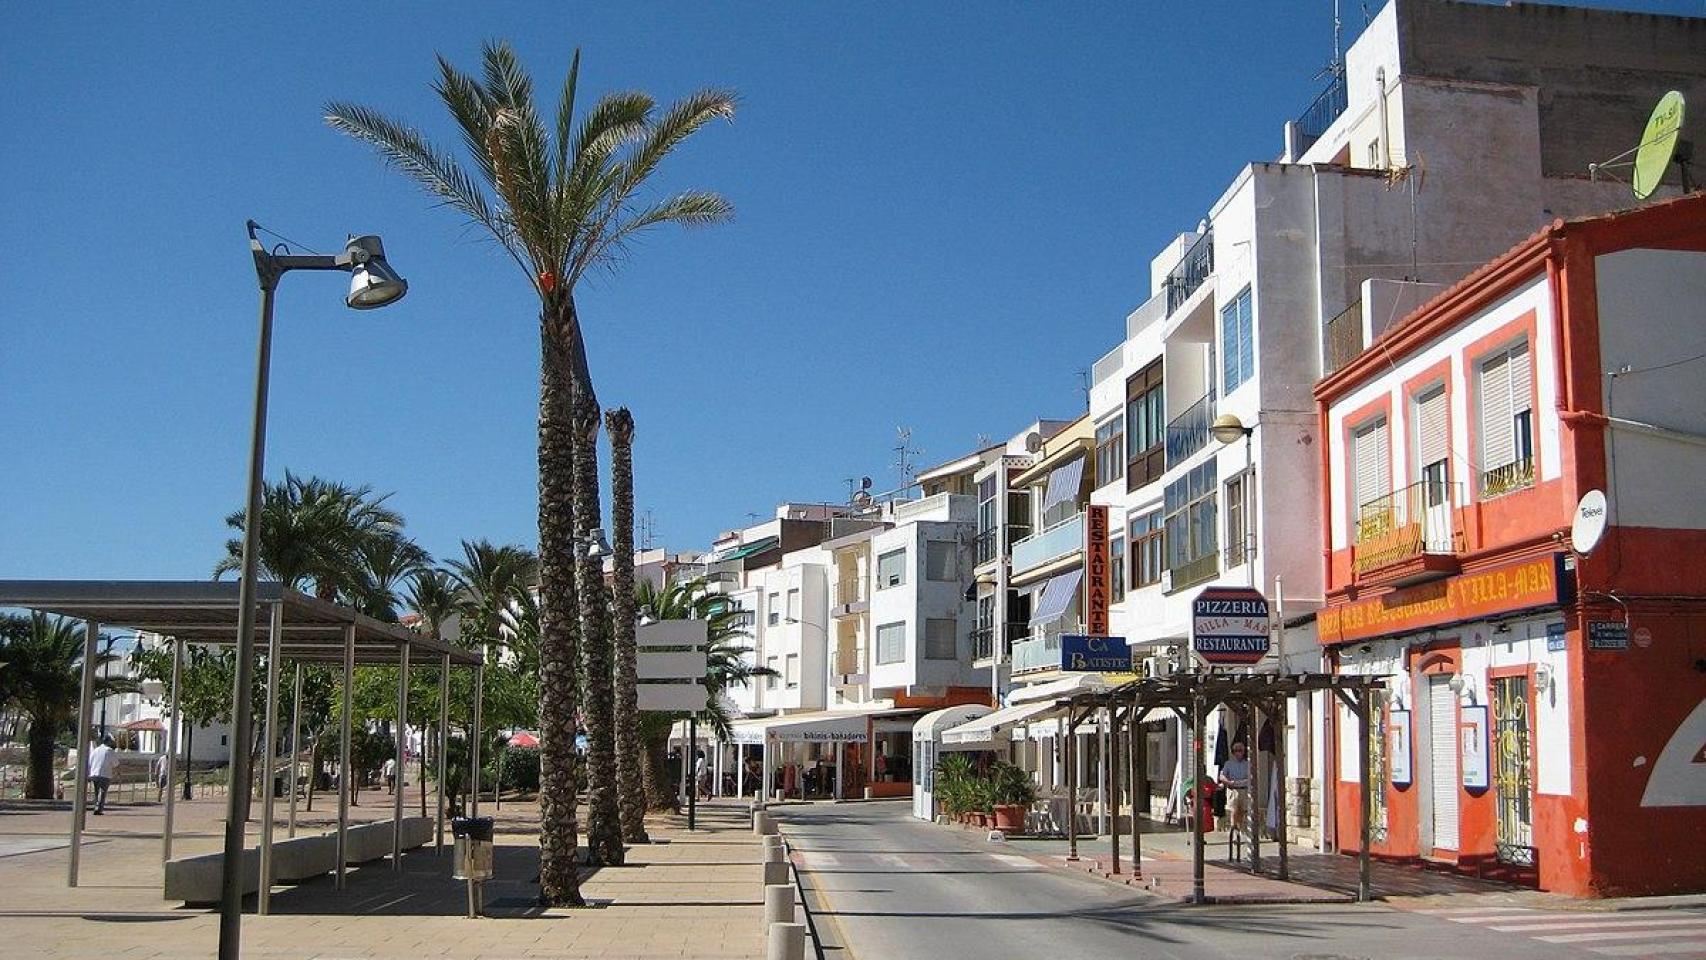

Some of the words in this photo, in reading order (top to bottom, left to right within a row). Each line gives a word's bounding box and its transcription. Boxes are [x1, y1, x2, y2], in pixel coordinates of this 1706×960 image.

[1091, 508, 1104, 633] RESTAURANTE
[1196, 601, 1268, 614] PIZZERIA
[1198, 618, 1229, 634] VILLA
[1244, 618, 1268, 634] MAR
[1196, 638, 1268, 651] RESTAURANTE
